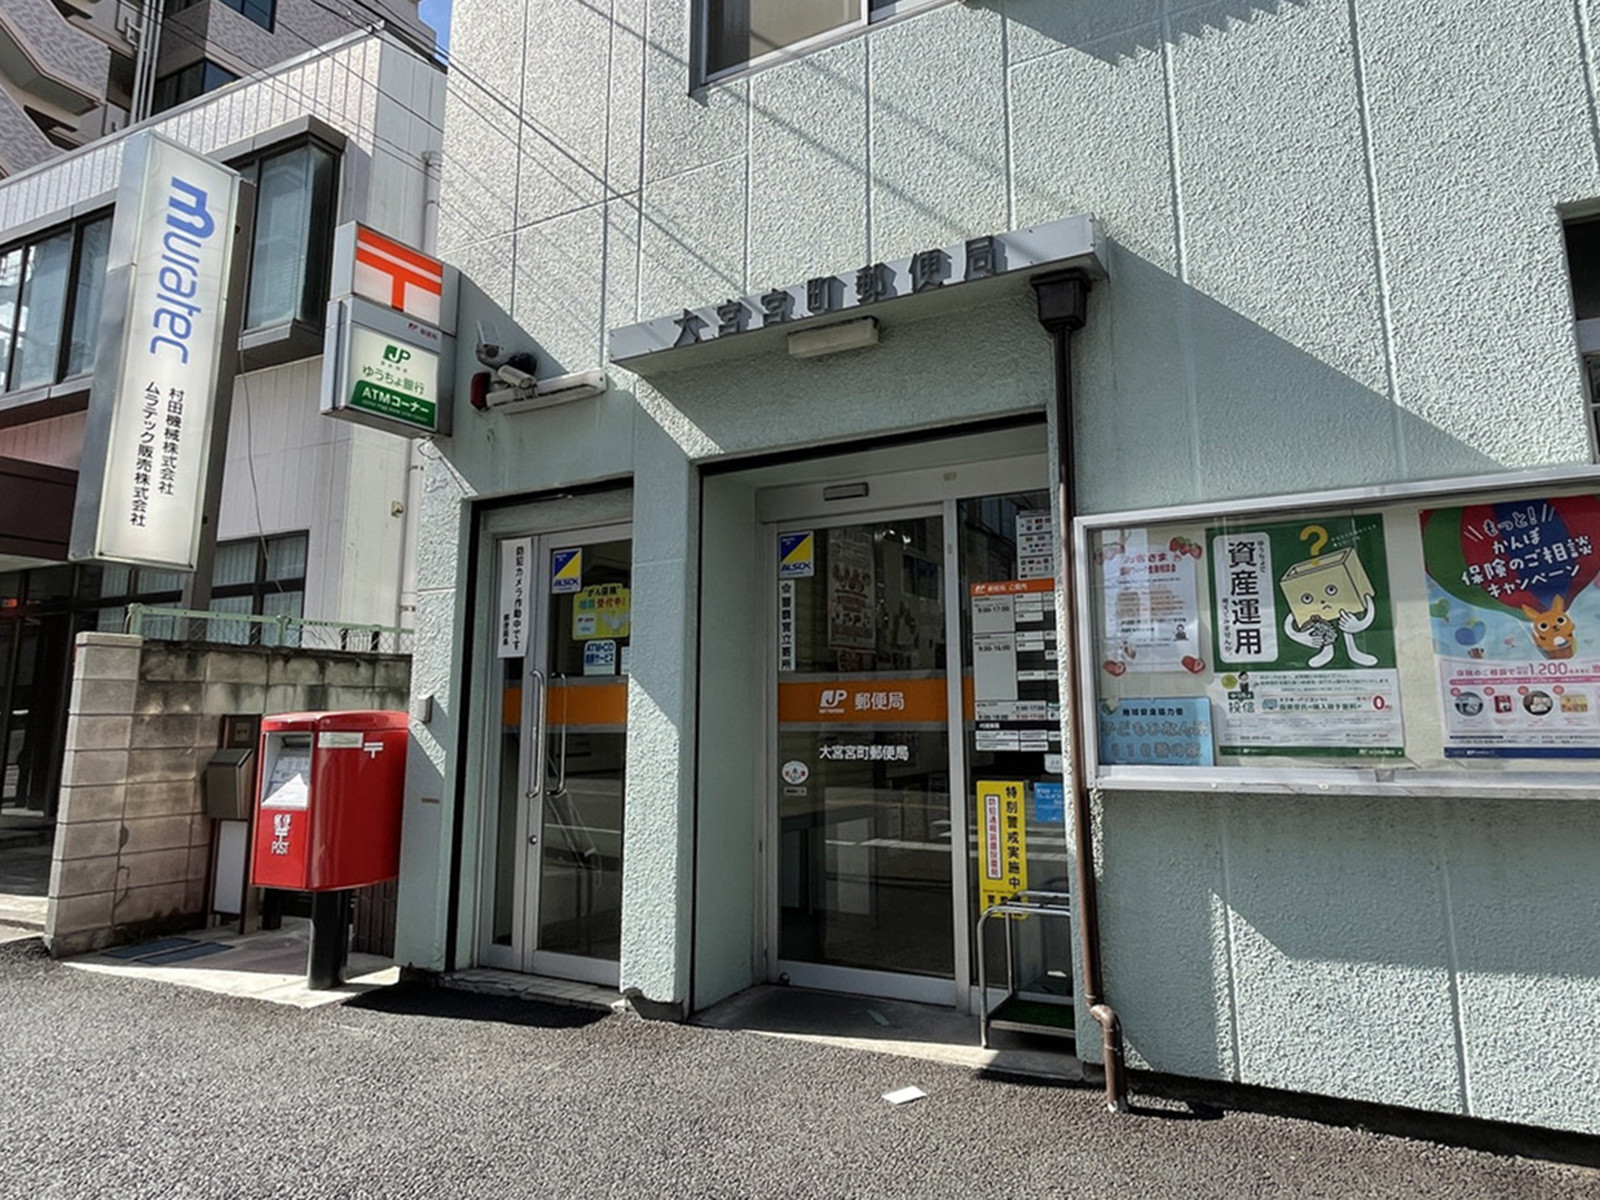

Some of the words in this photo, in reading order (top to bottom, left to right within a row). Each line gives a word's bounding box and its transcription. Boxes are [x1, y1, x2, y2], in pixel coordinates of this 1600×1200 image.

[150, 176, 215, 364] muratec
[673, 235, 1005, 348] 大宮宮町郵便局
[383, 344, 411, 364] JP
[363, 366, 424, 395] ゆうちょ銀行
[362, 387, 429, 412] ATMコーナー
[130, 381, 160, 527] ムラテック販売株式会社
[158, 388, 184, 495] 村田機械株式会社
[781, 562, 811, 571] ALSOK
[1461, 536, 1592, 586] 保険のご相談
[1488, 565, 1580, 597] キャンペーン
[1228, 541, 1262, 654] 資産運用
[820, 690, 847, 708] JP
[854, 691, 904, 711] 郵便局
[819, 745, 909, 761] 大宮宮町郵便局
[1005, 786, 1021, 890] 特別警戒実施中
